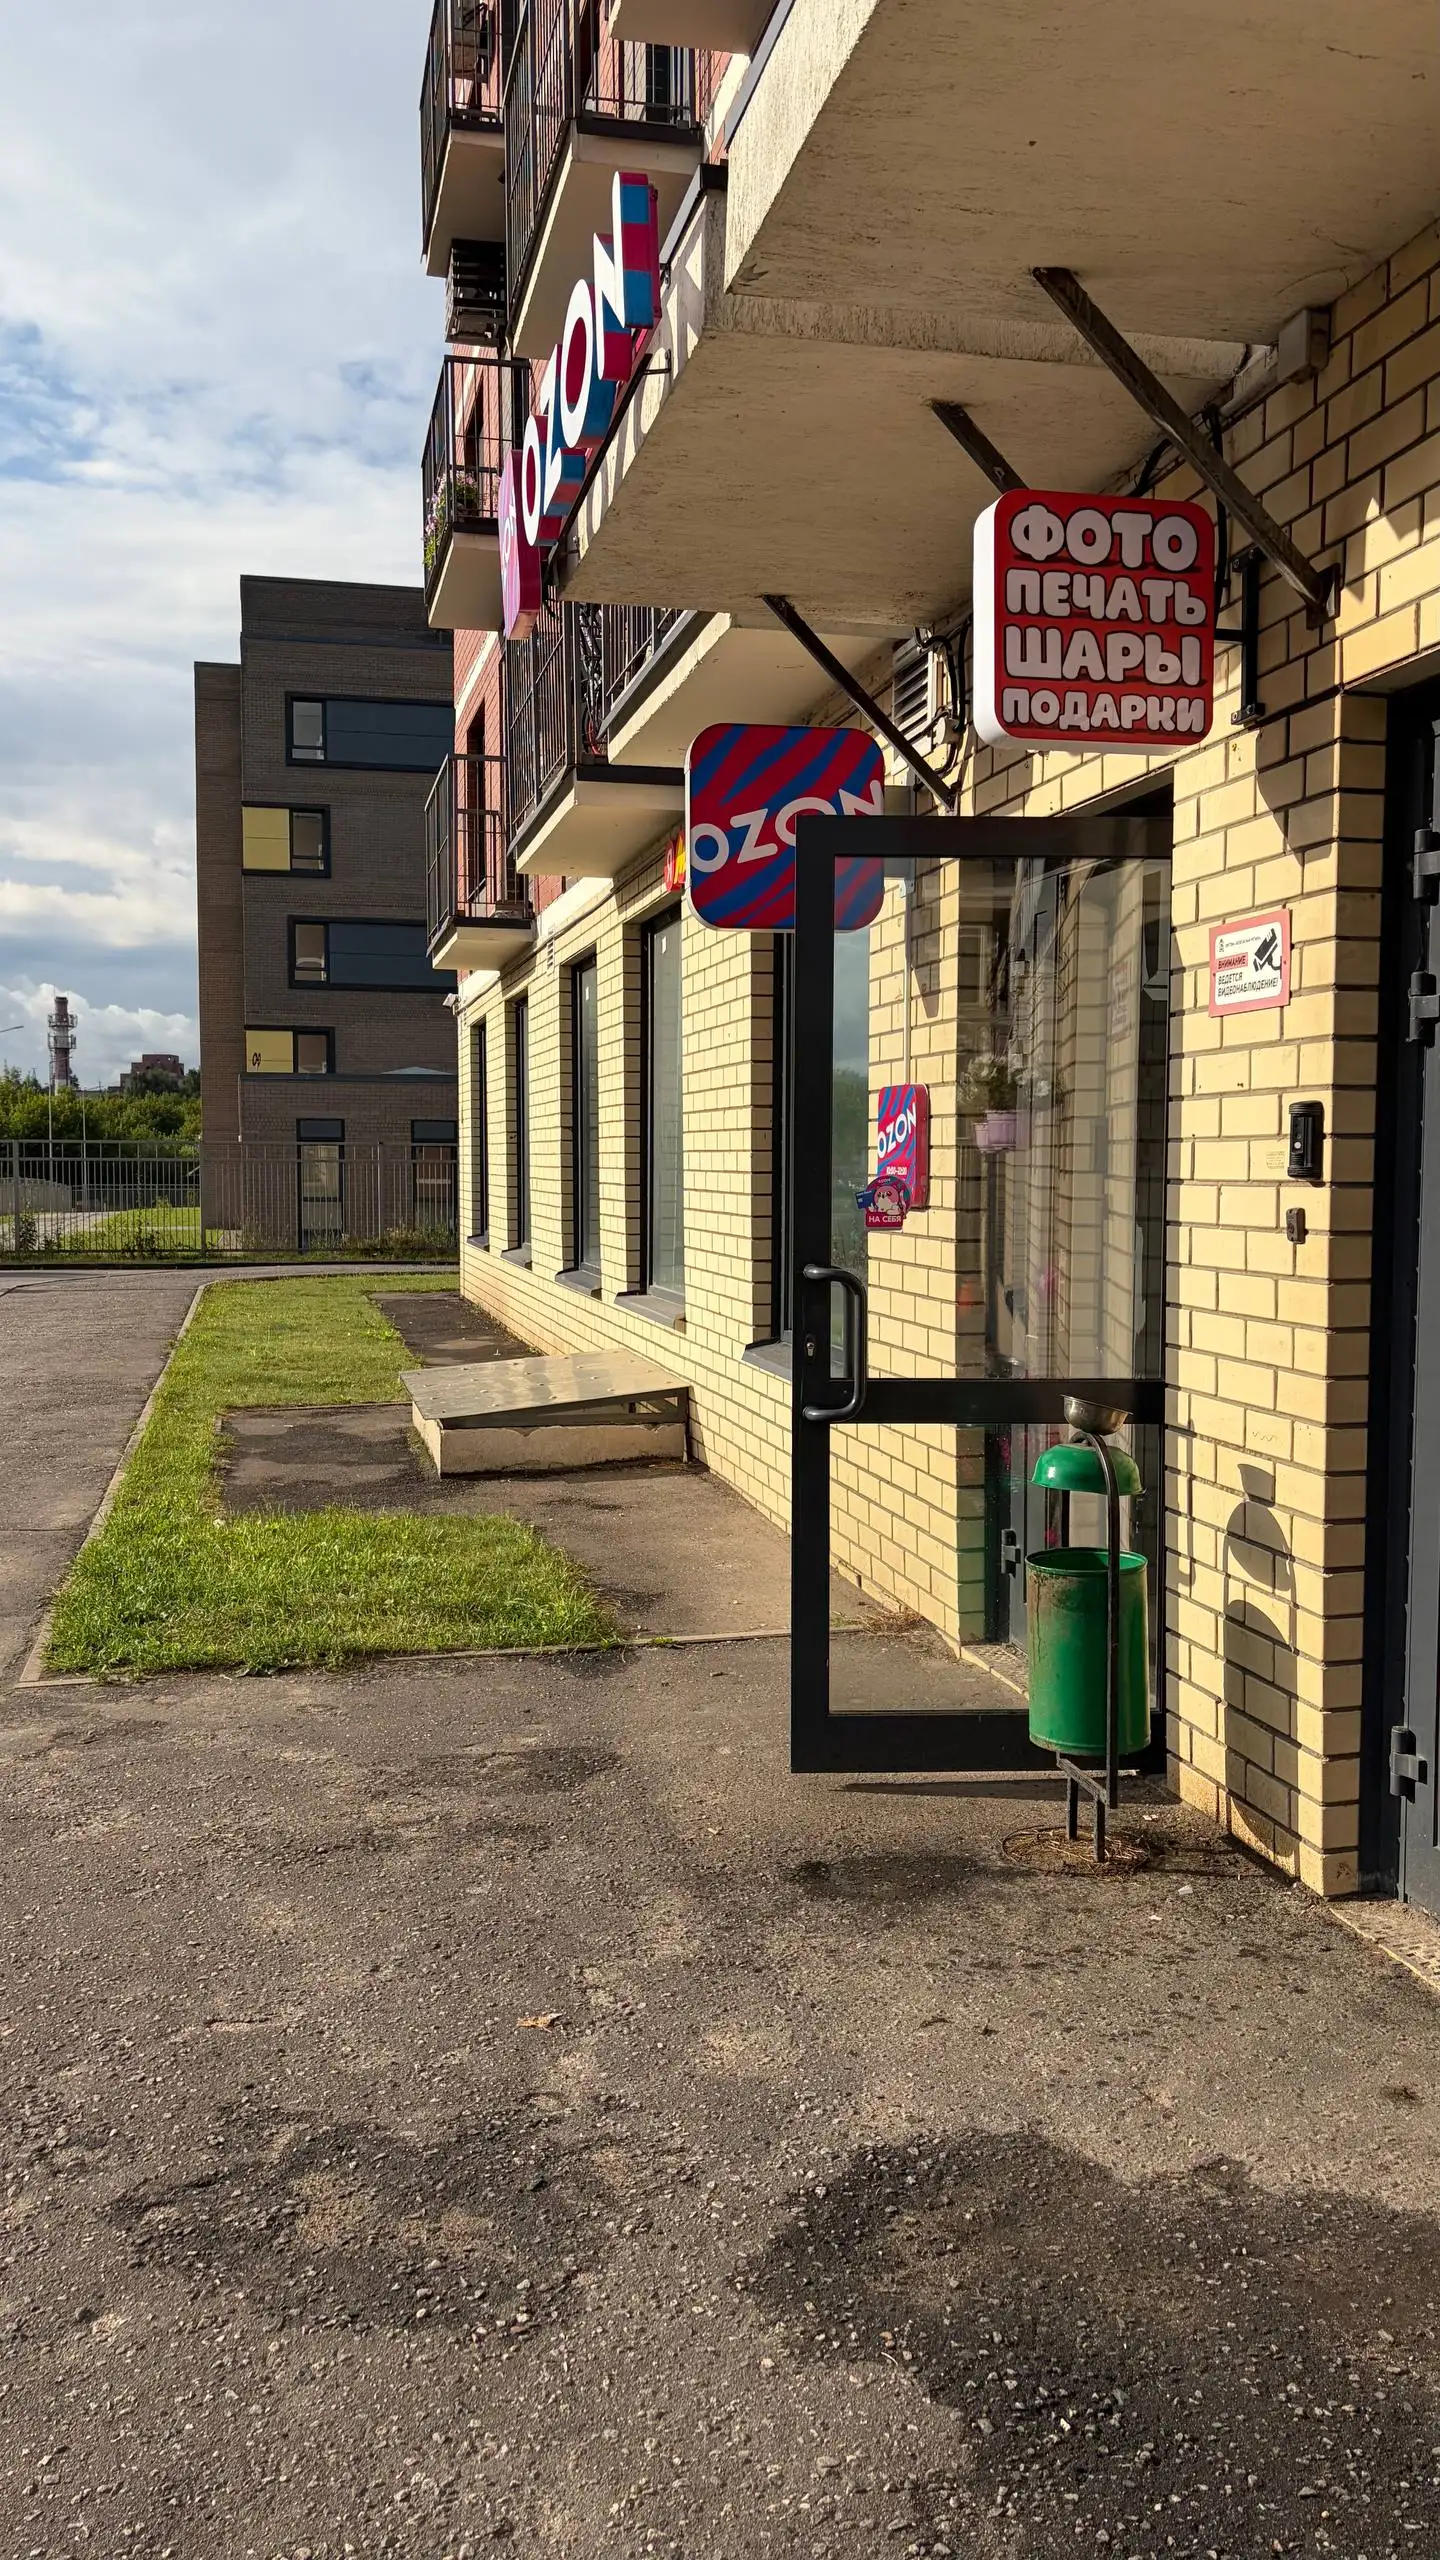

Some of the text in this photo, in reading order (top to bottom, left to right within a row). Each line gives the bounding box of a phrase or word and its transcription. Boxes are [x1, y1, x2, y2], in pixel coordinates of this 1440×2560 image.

[521, 171, 626, 547] OZON
[1010, 504, 1198, 572] ФОТО
[1005, 568, 1207, 626] ПЕЧАТЬ
[1004, 625, 1201, 687] ШАРЫ
[1001, 687, 1205, 733] ПОДАРКИ
[1218, 955, 1246, 969] ВНИМАНИЕ
[1218, 972, 1243, 985] ВЕДЕТСЯ
[877, 1102, 917, 1159] OZON
[868, 1215, 902, 1223] НА СЕБЯ
